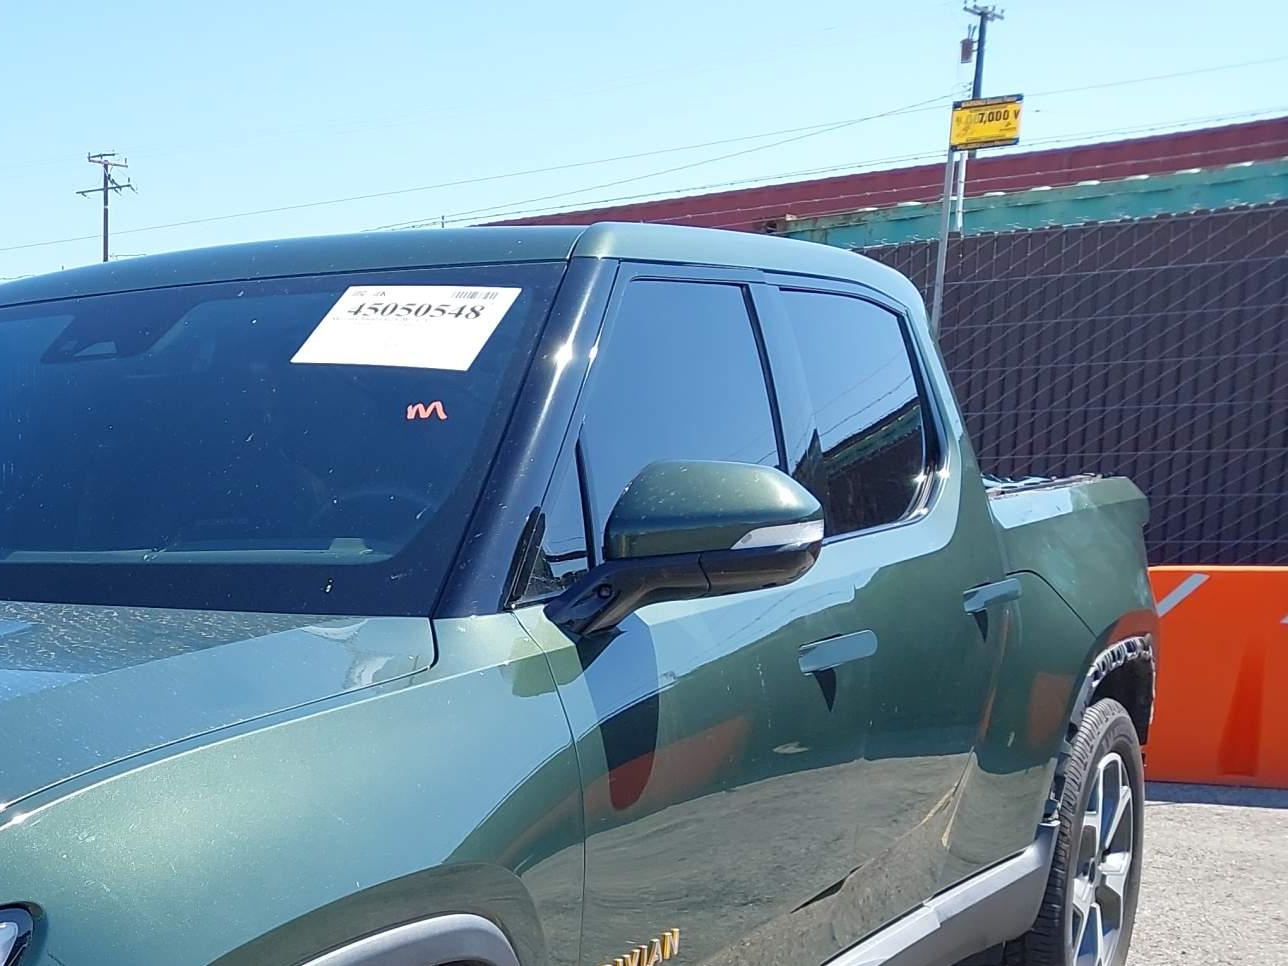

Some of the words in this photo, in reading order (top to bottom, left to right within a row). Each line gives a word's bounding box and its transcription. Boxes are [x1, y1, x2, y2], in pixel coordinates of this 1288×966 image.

[978, 109, 1010, 124] 7,000
[1014, 109, 1021, 120] V
[347, 302, 486, 320] 45050548
